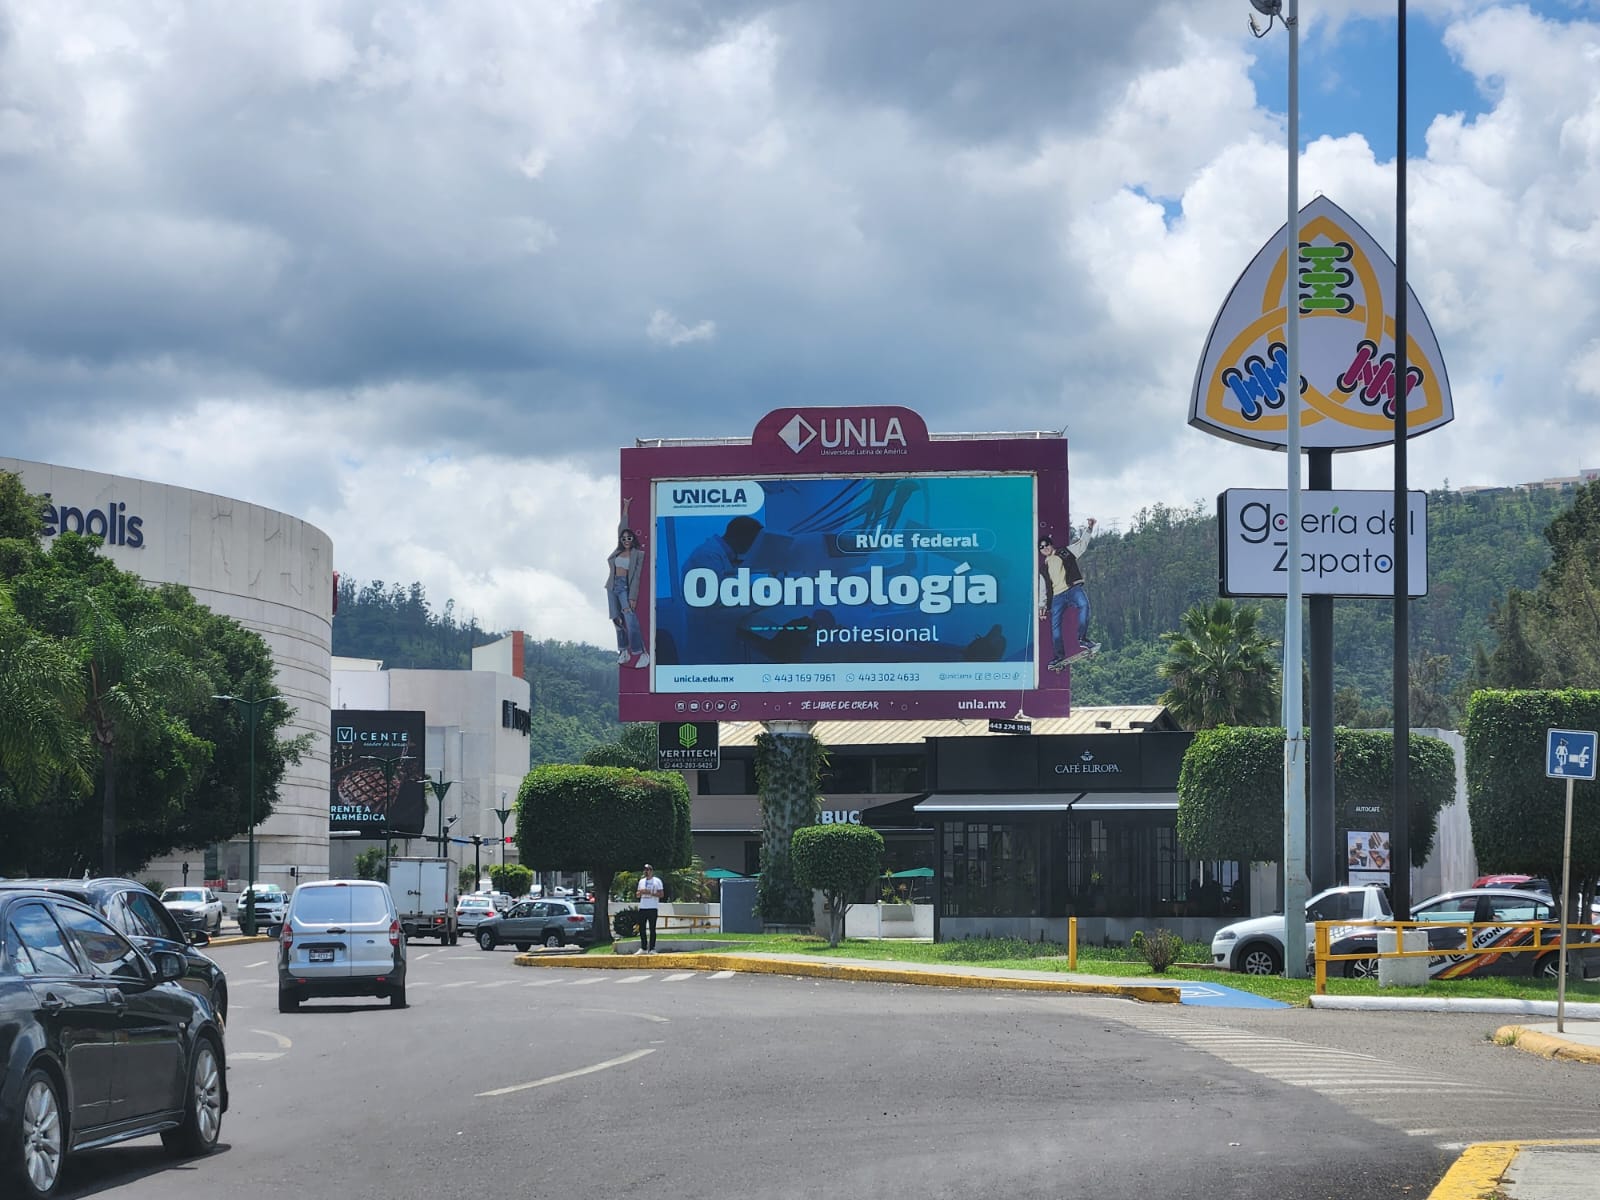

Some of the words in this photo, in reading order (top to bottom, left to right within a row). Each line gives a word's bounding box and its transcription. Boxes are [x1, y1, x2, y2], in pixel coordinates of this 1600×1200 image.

[820, 417, 907, 448] UNLA
[672, 488, 747, 504] UNICLA
[1240, 502, 1357, 543] gaería
[856, 524, 904, 548] RVOE
[911, 533, 980, 548] federal
[1272, 541, 1393, 578] Zapato
[683, 562, 998, 614] Odontología
[674, 675, 734, 683] unicla.edu.mx
[774, 673, 793, 682] 443
[795, 673, 812, 682] 169
[815, 673, 836, 682] 7961
[858, 673, 876, 682] 443
[878, 673, 895, 682] 302
[897, 673, 920, 681] 4633
[813, 701, 837, 710] LIBRE
[838, 701, 850, 710] DE
[851, 701, 879, 710] CREAR
[958, 699, 1007, 709] unla.mx
[339, 729, 408, 741] VICENTE
[660, 749, 717, 758] VERTITECH
[1055, 763, 1081, 774] CAFÉ
[1082, 763, 1119, 773] EUROPA
[364, 805, 371, 813] A
[818, 810, 861, 824] BUC
